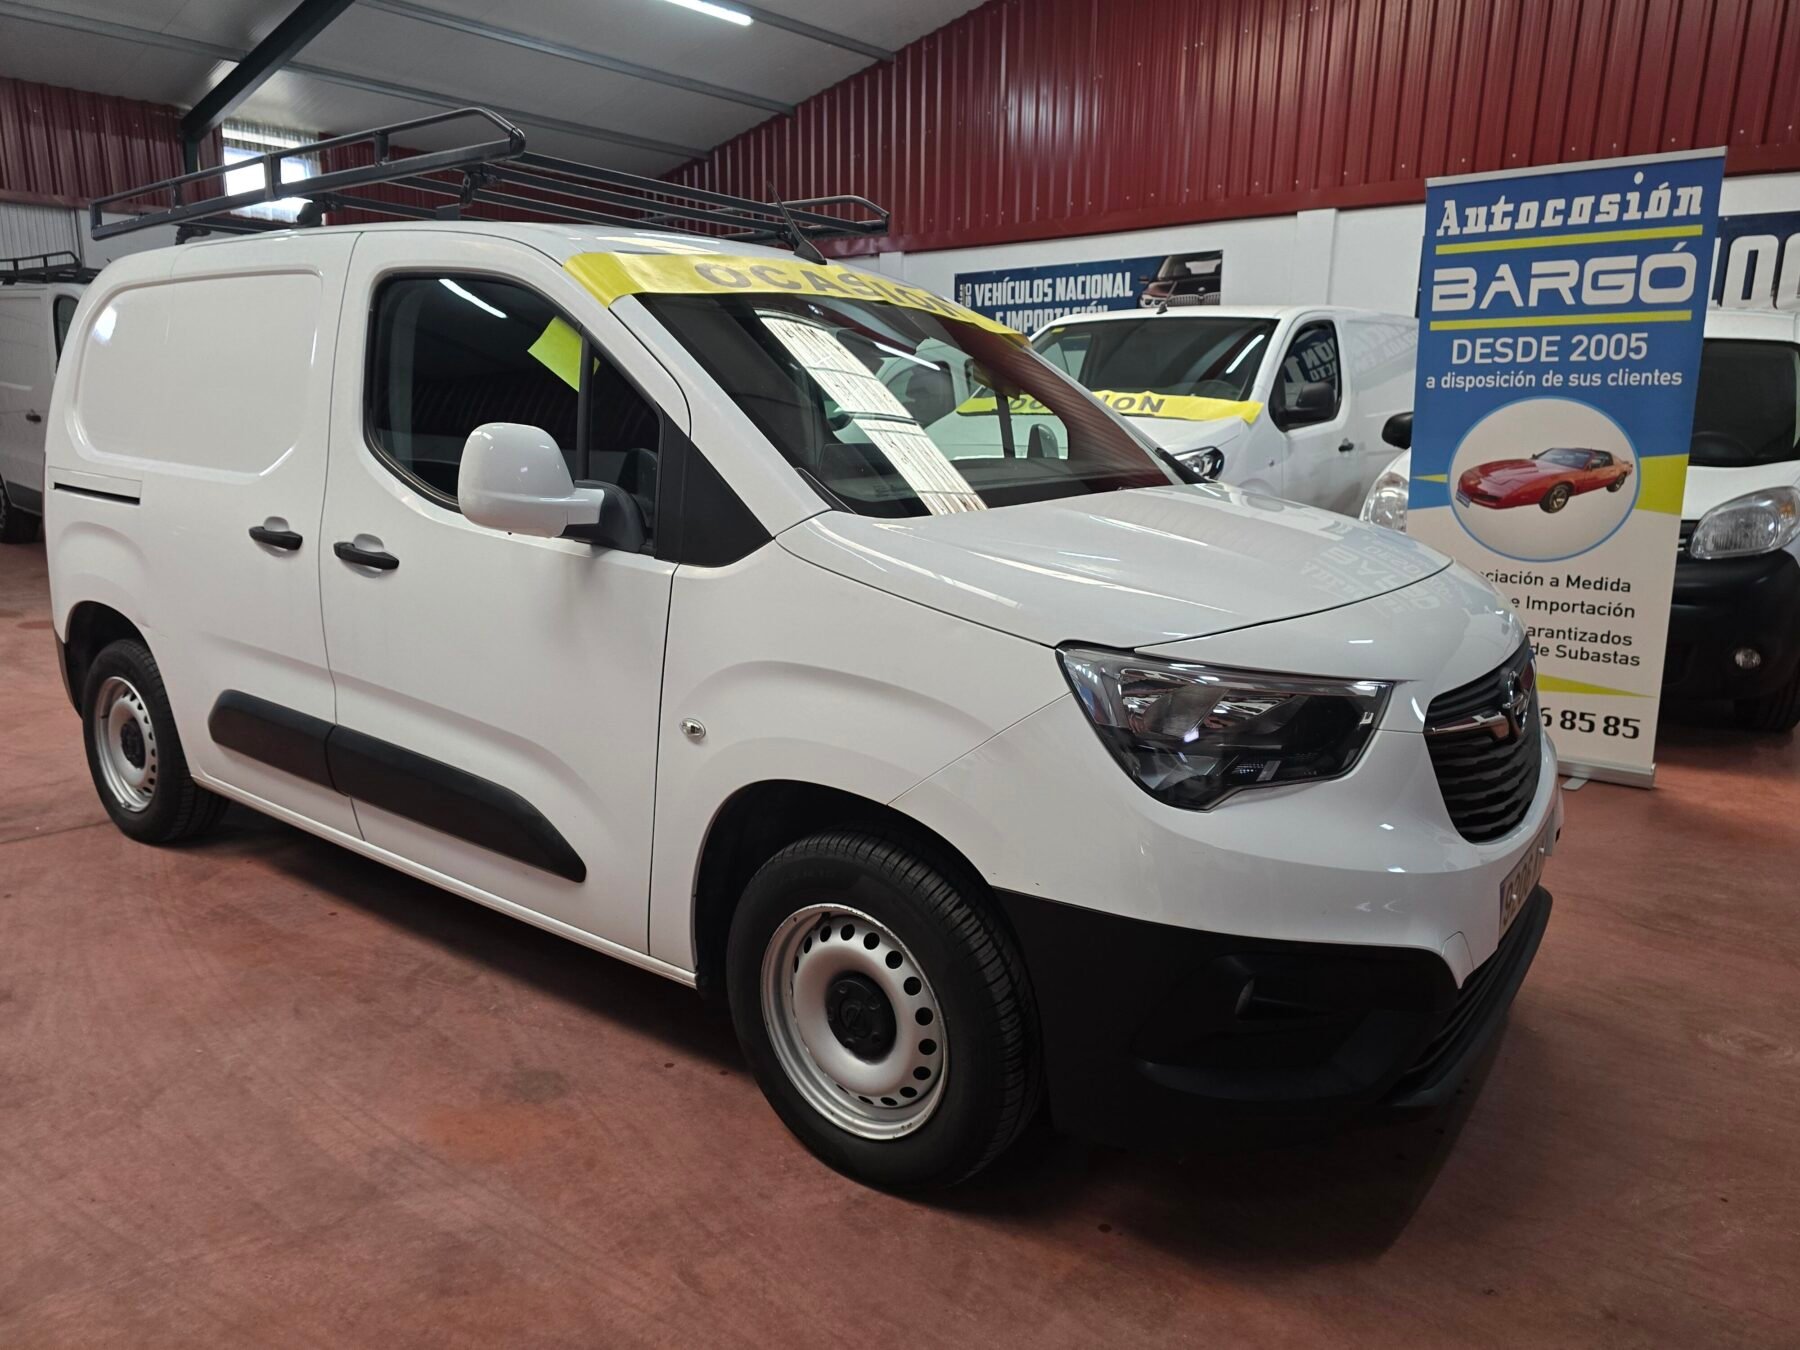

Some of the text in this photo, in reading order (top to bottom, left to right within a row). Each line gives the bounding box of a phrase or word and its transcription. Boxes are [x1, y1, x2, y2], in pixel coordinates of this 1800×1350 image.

[1436, 171, 1703, 237] Autocasión
[974, 277, 1053, 307] VEHÍCULOS
[1055, 271, 1133, 302] NACIONAL
[1431, 241, 1697, 311] BARGÓ
[1451, 336, 1561, 365] DESDE
[1569, 332, 1649, 362] 2005
[1425, 367, 1683, 392] a disposición de sus clientes
[1480, 569, 1631, 593] ciación a Medida
[1526, 595, 1636, 618] Importación
[1526, 626, 1633, 646] arantizados
[1555, 644, 1641, 667] Subastas
[1559, 709, 1597, 733] 85
[1602, 715, 1641, 739] 85
